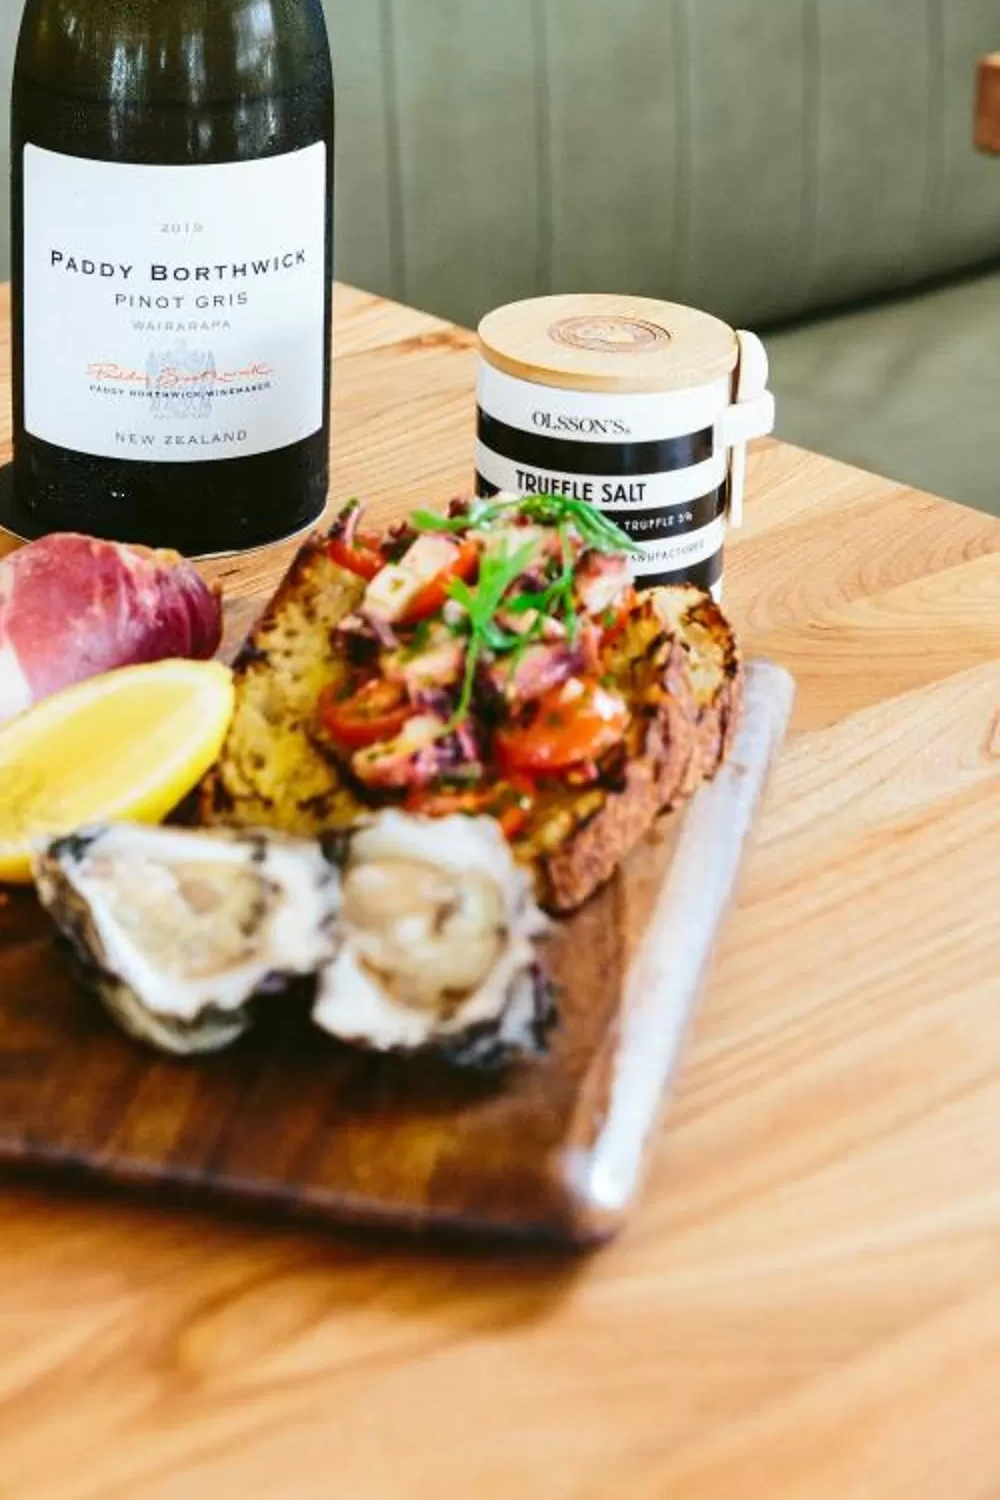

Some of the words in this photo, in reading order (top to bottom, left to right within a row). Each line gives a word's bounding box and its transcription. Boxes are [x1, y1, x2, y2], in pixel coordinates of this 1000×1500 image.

[50, 250, 133, 279] PADDY
[151, 249, 306, 282] BORTHWICK
[115, 293, 184, 309] PINOT
[195, 292, 248, 308] GRIS
[131, 319, 231, 332] WAIRARAPA
[89, 385, 124, 395] PADDY
[115, 431, 155, 445] NEW
[164, 429, 247, 445] ZEALAND
[516, 469, 593, 501] TRUFFLE
[601, 483, 647, 502] SALT
[625, 515, 674, 531] TRUFFLE
